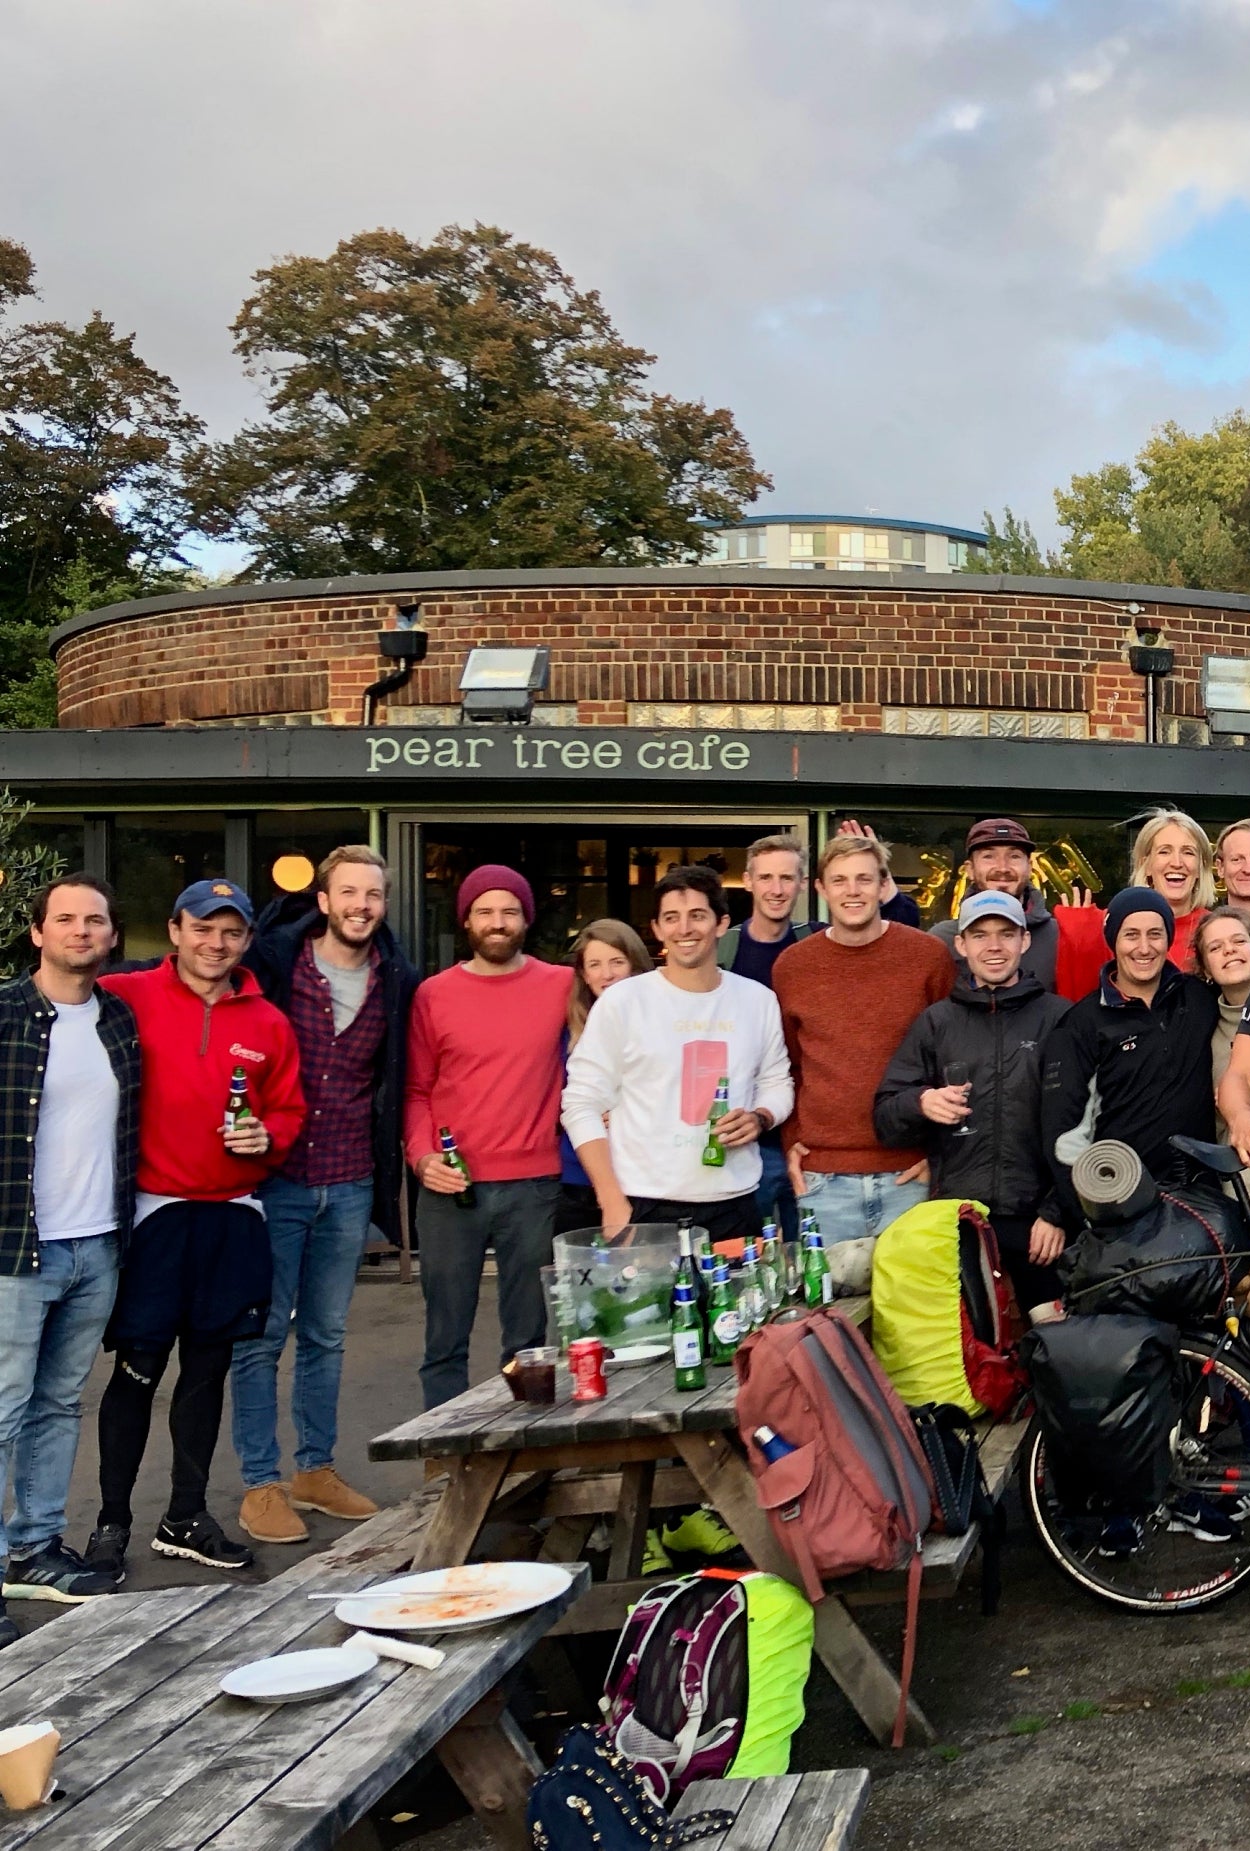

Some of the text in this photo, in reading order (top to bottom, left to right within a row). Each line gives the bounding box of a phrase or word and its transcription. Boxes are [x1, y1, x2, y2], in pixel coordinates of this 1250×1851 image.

[366, 734, 750, 772] pear tree cafe
[1173, 1573, 1227, 1599] TAURUS
